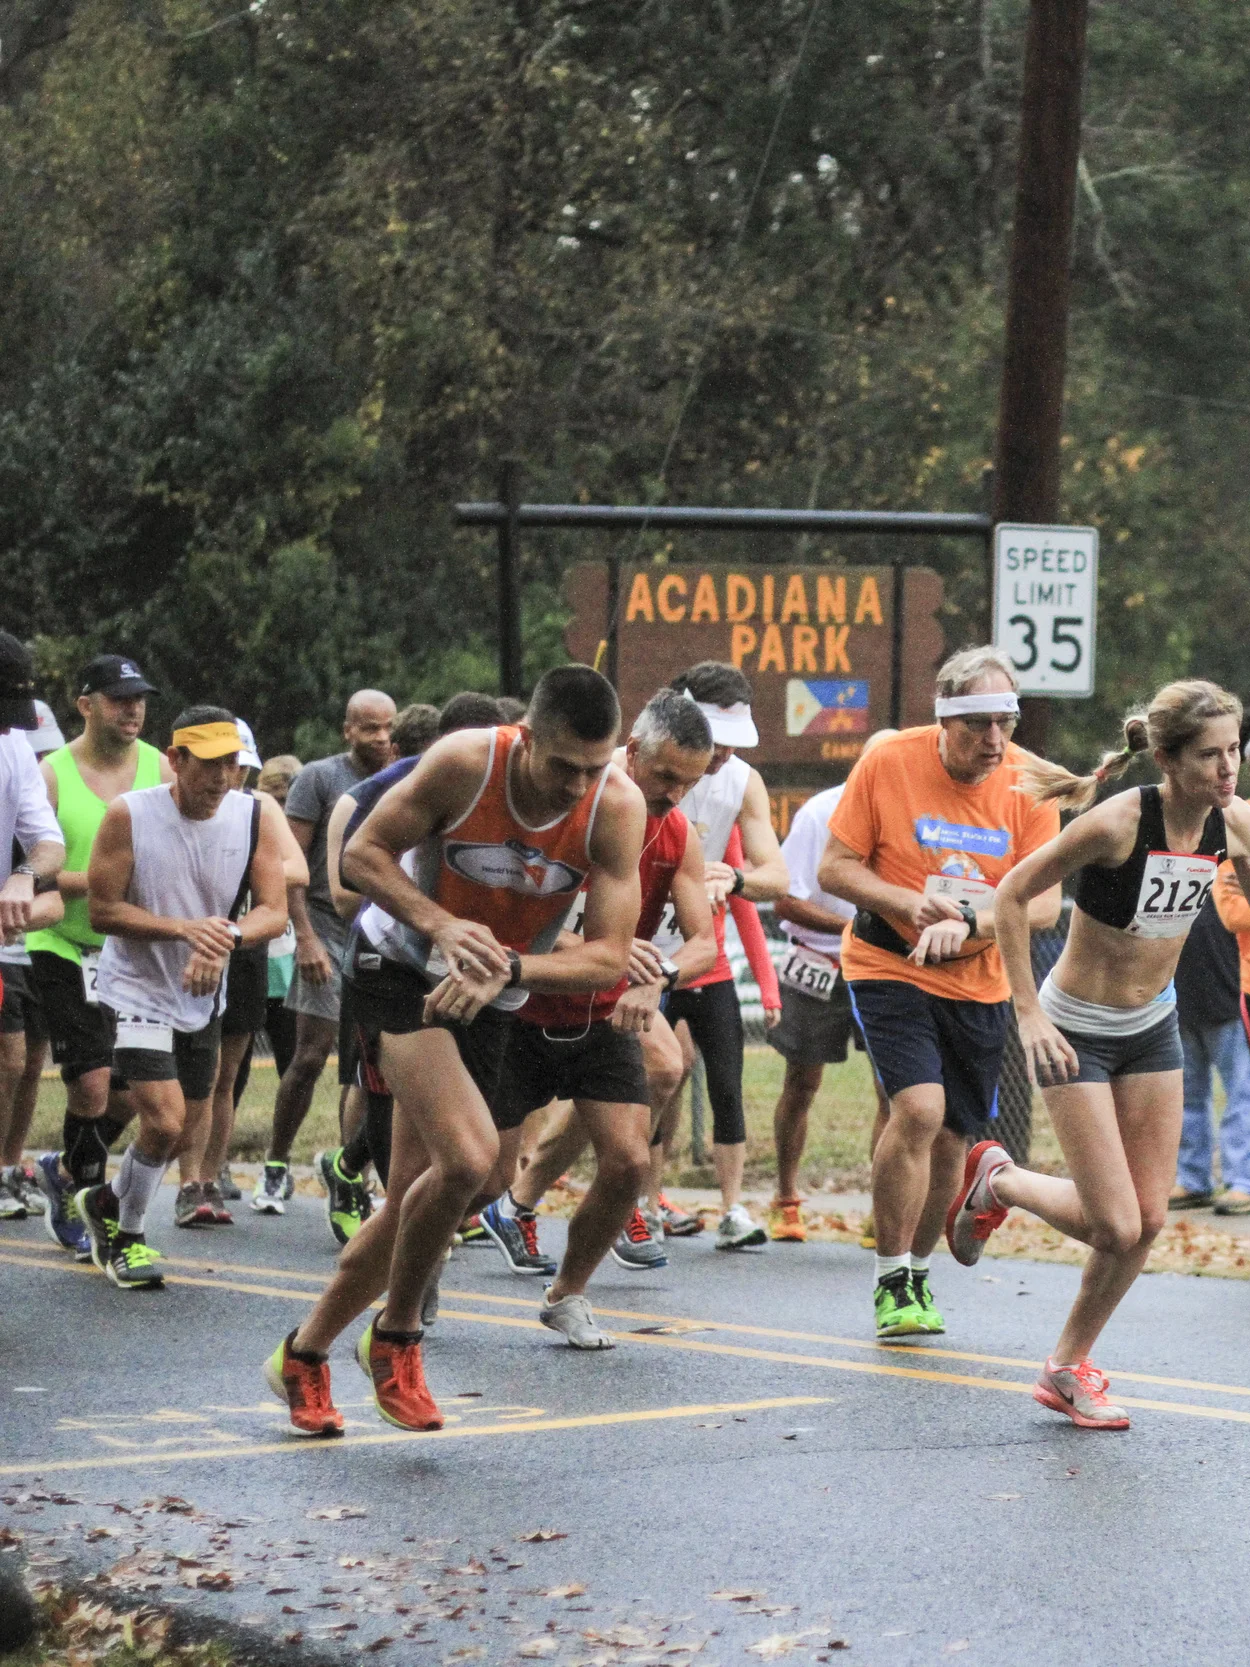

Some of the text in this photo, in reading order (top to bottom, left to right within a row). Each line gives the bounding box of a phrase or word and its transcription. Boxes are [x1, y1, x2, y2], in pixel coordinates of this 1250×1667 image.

[1007, 547, 1087, 573] SPEED
[626, 573, 884, 625] ACADIANA
[1014, 582, 1077, 605] LIMIT
[731, 623, 851, 673] PARK
[1009, 614, 1083, 673] 35
[1143, 877, 1213, 912] 2126
[783, 955, 831, 993] 1450
